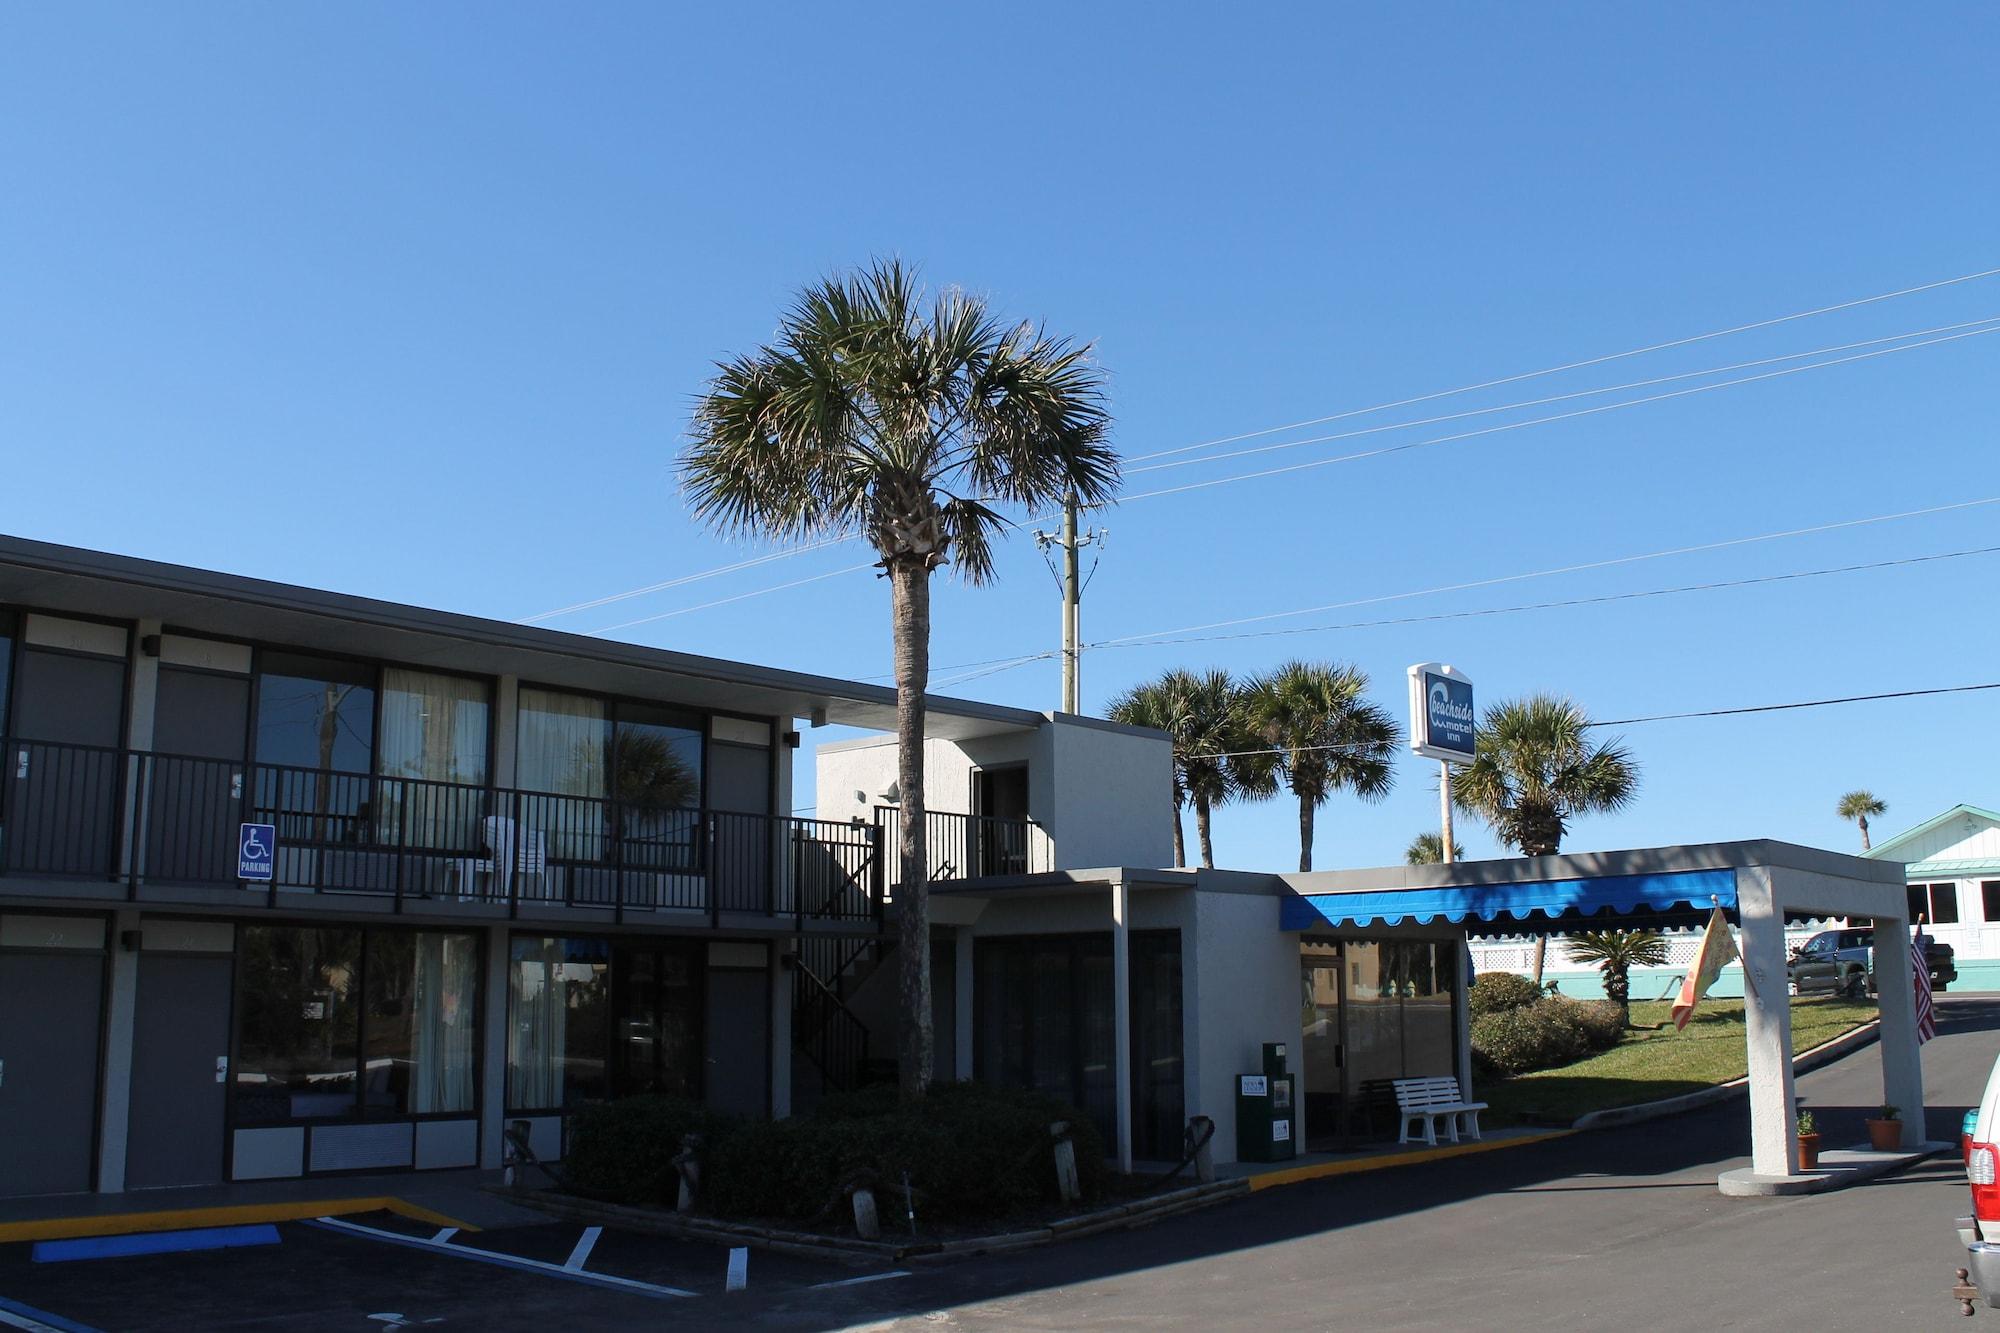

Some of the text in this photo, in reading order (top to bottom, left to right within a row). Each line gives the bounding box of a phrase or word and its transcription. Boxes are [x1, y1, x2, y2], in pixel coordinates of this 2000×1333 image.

[1432, 695, 1472, 721] beachside
[1447, 721, 1472, 734] motel
[1447, 731, 1460, 742] inn
[241, 861, 270, 873] PARKING
